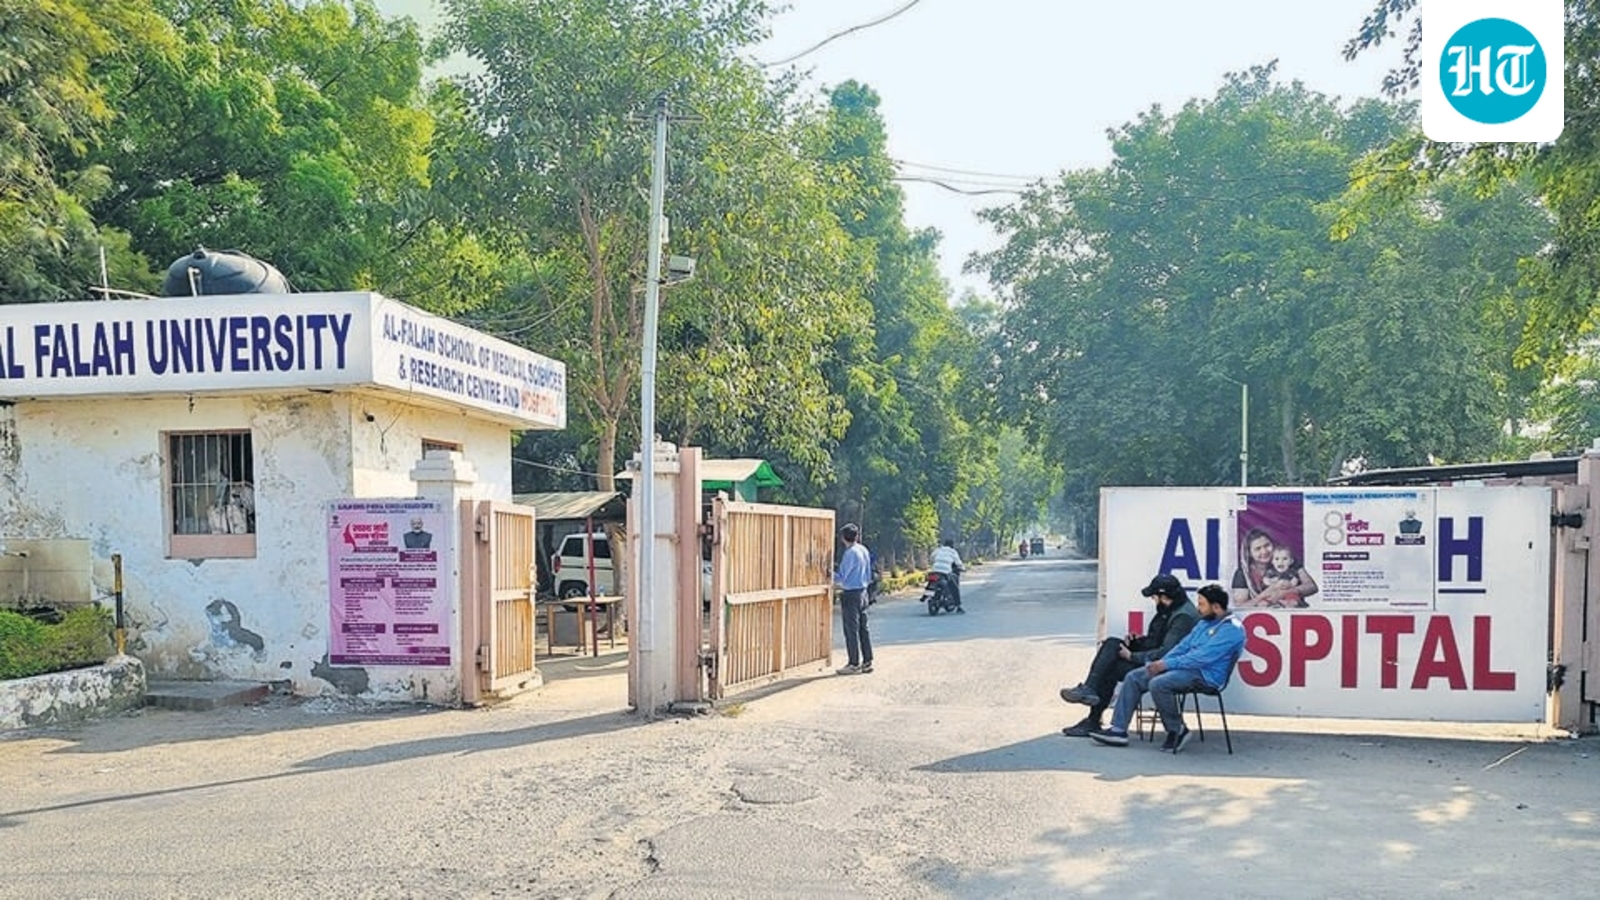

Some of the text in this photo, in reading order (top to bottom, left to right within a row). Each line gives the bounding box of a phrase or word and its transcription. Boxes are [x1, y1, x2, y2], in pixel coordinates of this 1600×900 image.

[35, 321, 136, 378] FALAH
[147, 313, 352, 376] UNIVERSITY
[383, 313, 563, 392] AL-FALAH SCHOOL OF MEDICAL SCIENCES
[399, 354, 407, 380] &
[410, 357, 465, 395] RESEARCH
[467, 374, 501, 404] CENTRE
[502, 385, 520, 409] AND
